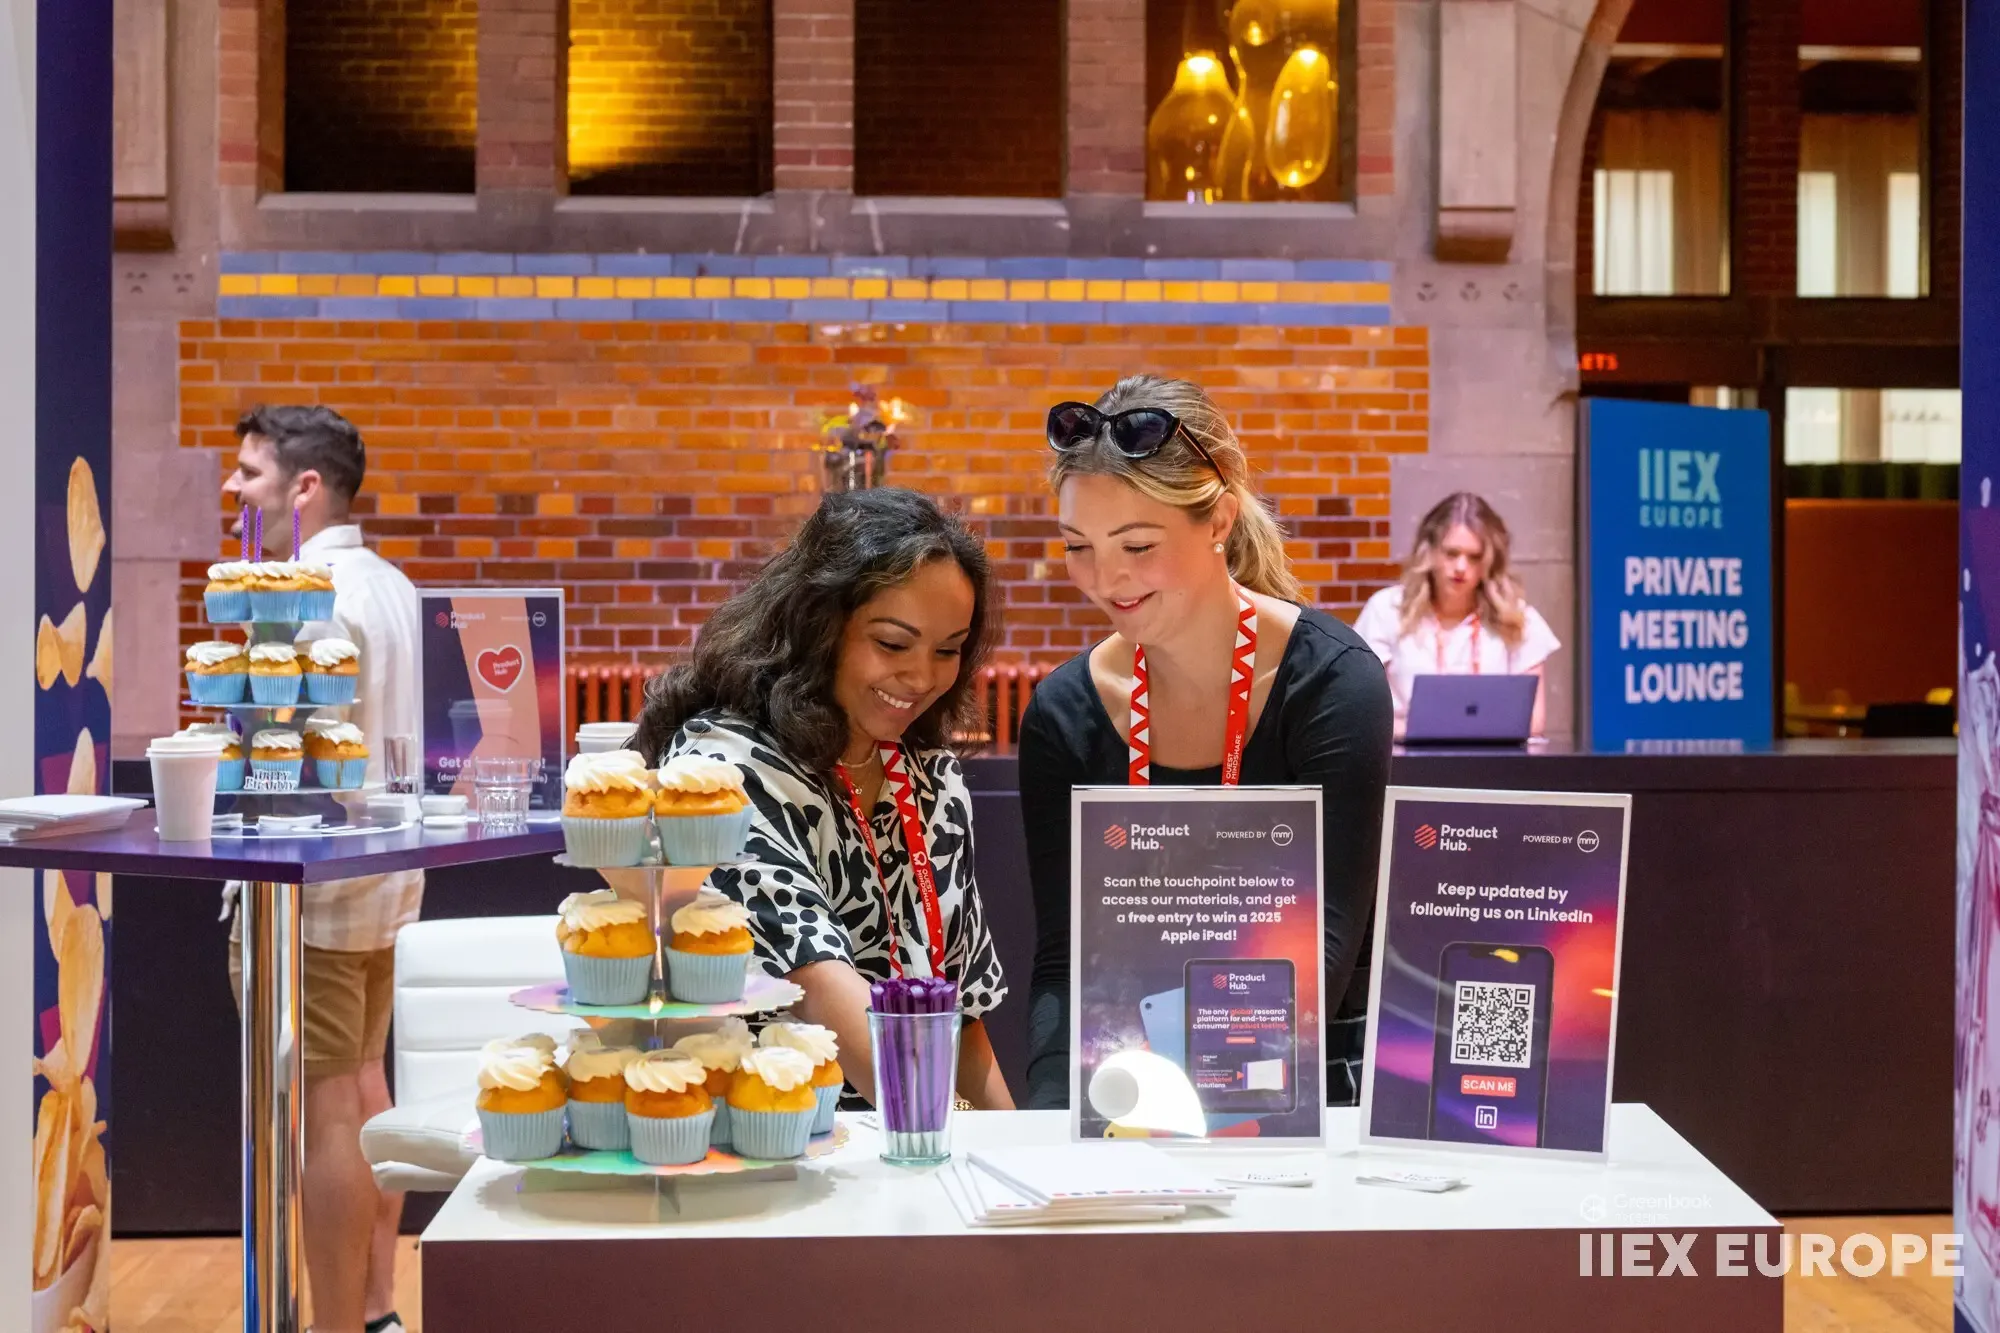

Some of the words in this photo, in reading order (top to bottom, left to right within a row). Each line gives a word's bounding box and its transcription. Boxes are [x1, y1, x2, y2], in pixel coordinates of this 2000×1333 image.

[1577, 354, 1618, 371] ETS
[1639, 448, 1721, 504] IIEX
[1640, 505, 1723, 529] EUROPE
[1624, 556, 1743, 596] PRIVATE
[1619, 609, 1748, 650] MEETING
[1625, 661, 1744, 704] LOUNGE
[439, 756, 461, 768] Get
[463, 759, 471, 768] a
[1231, 734, 1242, 779] MINDSHARE
[1226, 753, 1234, 779] QUEST
[1131, 824, 1190, 836] Product
[1216, 831, 1255, 839] POWERED
[1256, 831, 1267, 839] BY
[1440, 824, 1498, 839] Product
[1440, 838, 1471, 852] Hub.
[1523, 835, 1561, 844] POWERED
[1562, 836, 1573, 844] BY
[922, 869, 934, 894] QUEST
[1103, 877, 1137, 888] Scan
[1139, 876, 1161, 888] the
[1164, 876, 1236, 890] touchpoint
[1239, 876, 1278, 888] below
[1281, 877, 1295, 888] to
[916, 870, 932, 913] MINDSHARE
[1437, 883, 1476, 900] Keep
[1479, 885, 1545, 901] updated
[1548, 887, 1569, 904] by
[1102, 896, 1148, 906] access
[1151, 896, 1173, 906] our
[1176, 894, 1242, 907] materials,
[1245, 894, 1272, 906] and
[1274, 895, 1297, 908] get
[1117, 914, 1126, 923] a
[1128, 911, 1155, 924] free
[1157, 913, 1194, 926] entry
[1196, 912, 1210, 924] to
[1212, 911, 1237, 923] win
[1239, 914, 1248, 923] a
[1250, 911, 1282, 924] 2025
[1410, 902, 1481, 922] following
[1483, 908, 1502, 919] us
[1504, 909, 1525, 920] on
[1527, 907, 1594, 924] LinkedIn
[1161, 929, 1200, 944] Apple
[1203, 929, 1237, 942] iPad!
[1229, 973, 1266, 982] Product
[1197, 1015, 1229, 1023] platform
[1241, 1015, 1285, 1023] end-to-end
[1198, 1008, 1212, 1016] The
[1213, 1008, 1229, 1017] only
[1254, 1008, 1287, 1016] research
[1231, 1022, 1260, 1031] product
[1463, 1079, 1495, 1091] SCAN
[1497, 1081, 1514, 1092] ME
[1479, 1110, 1493, 1125] in
